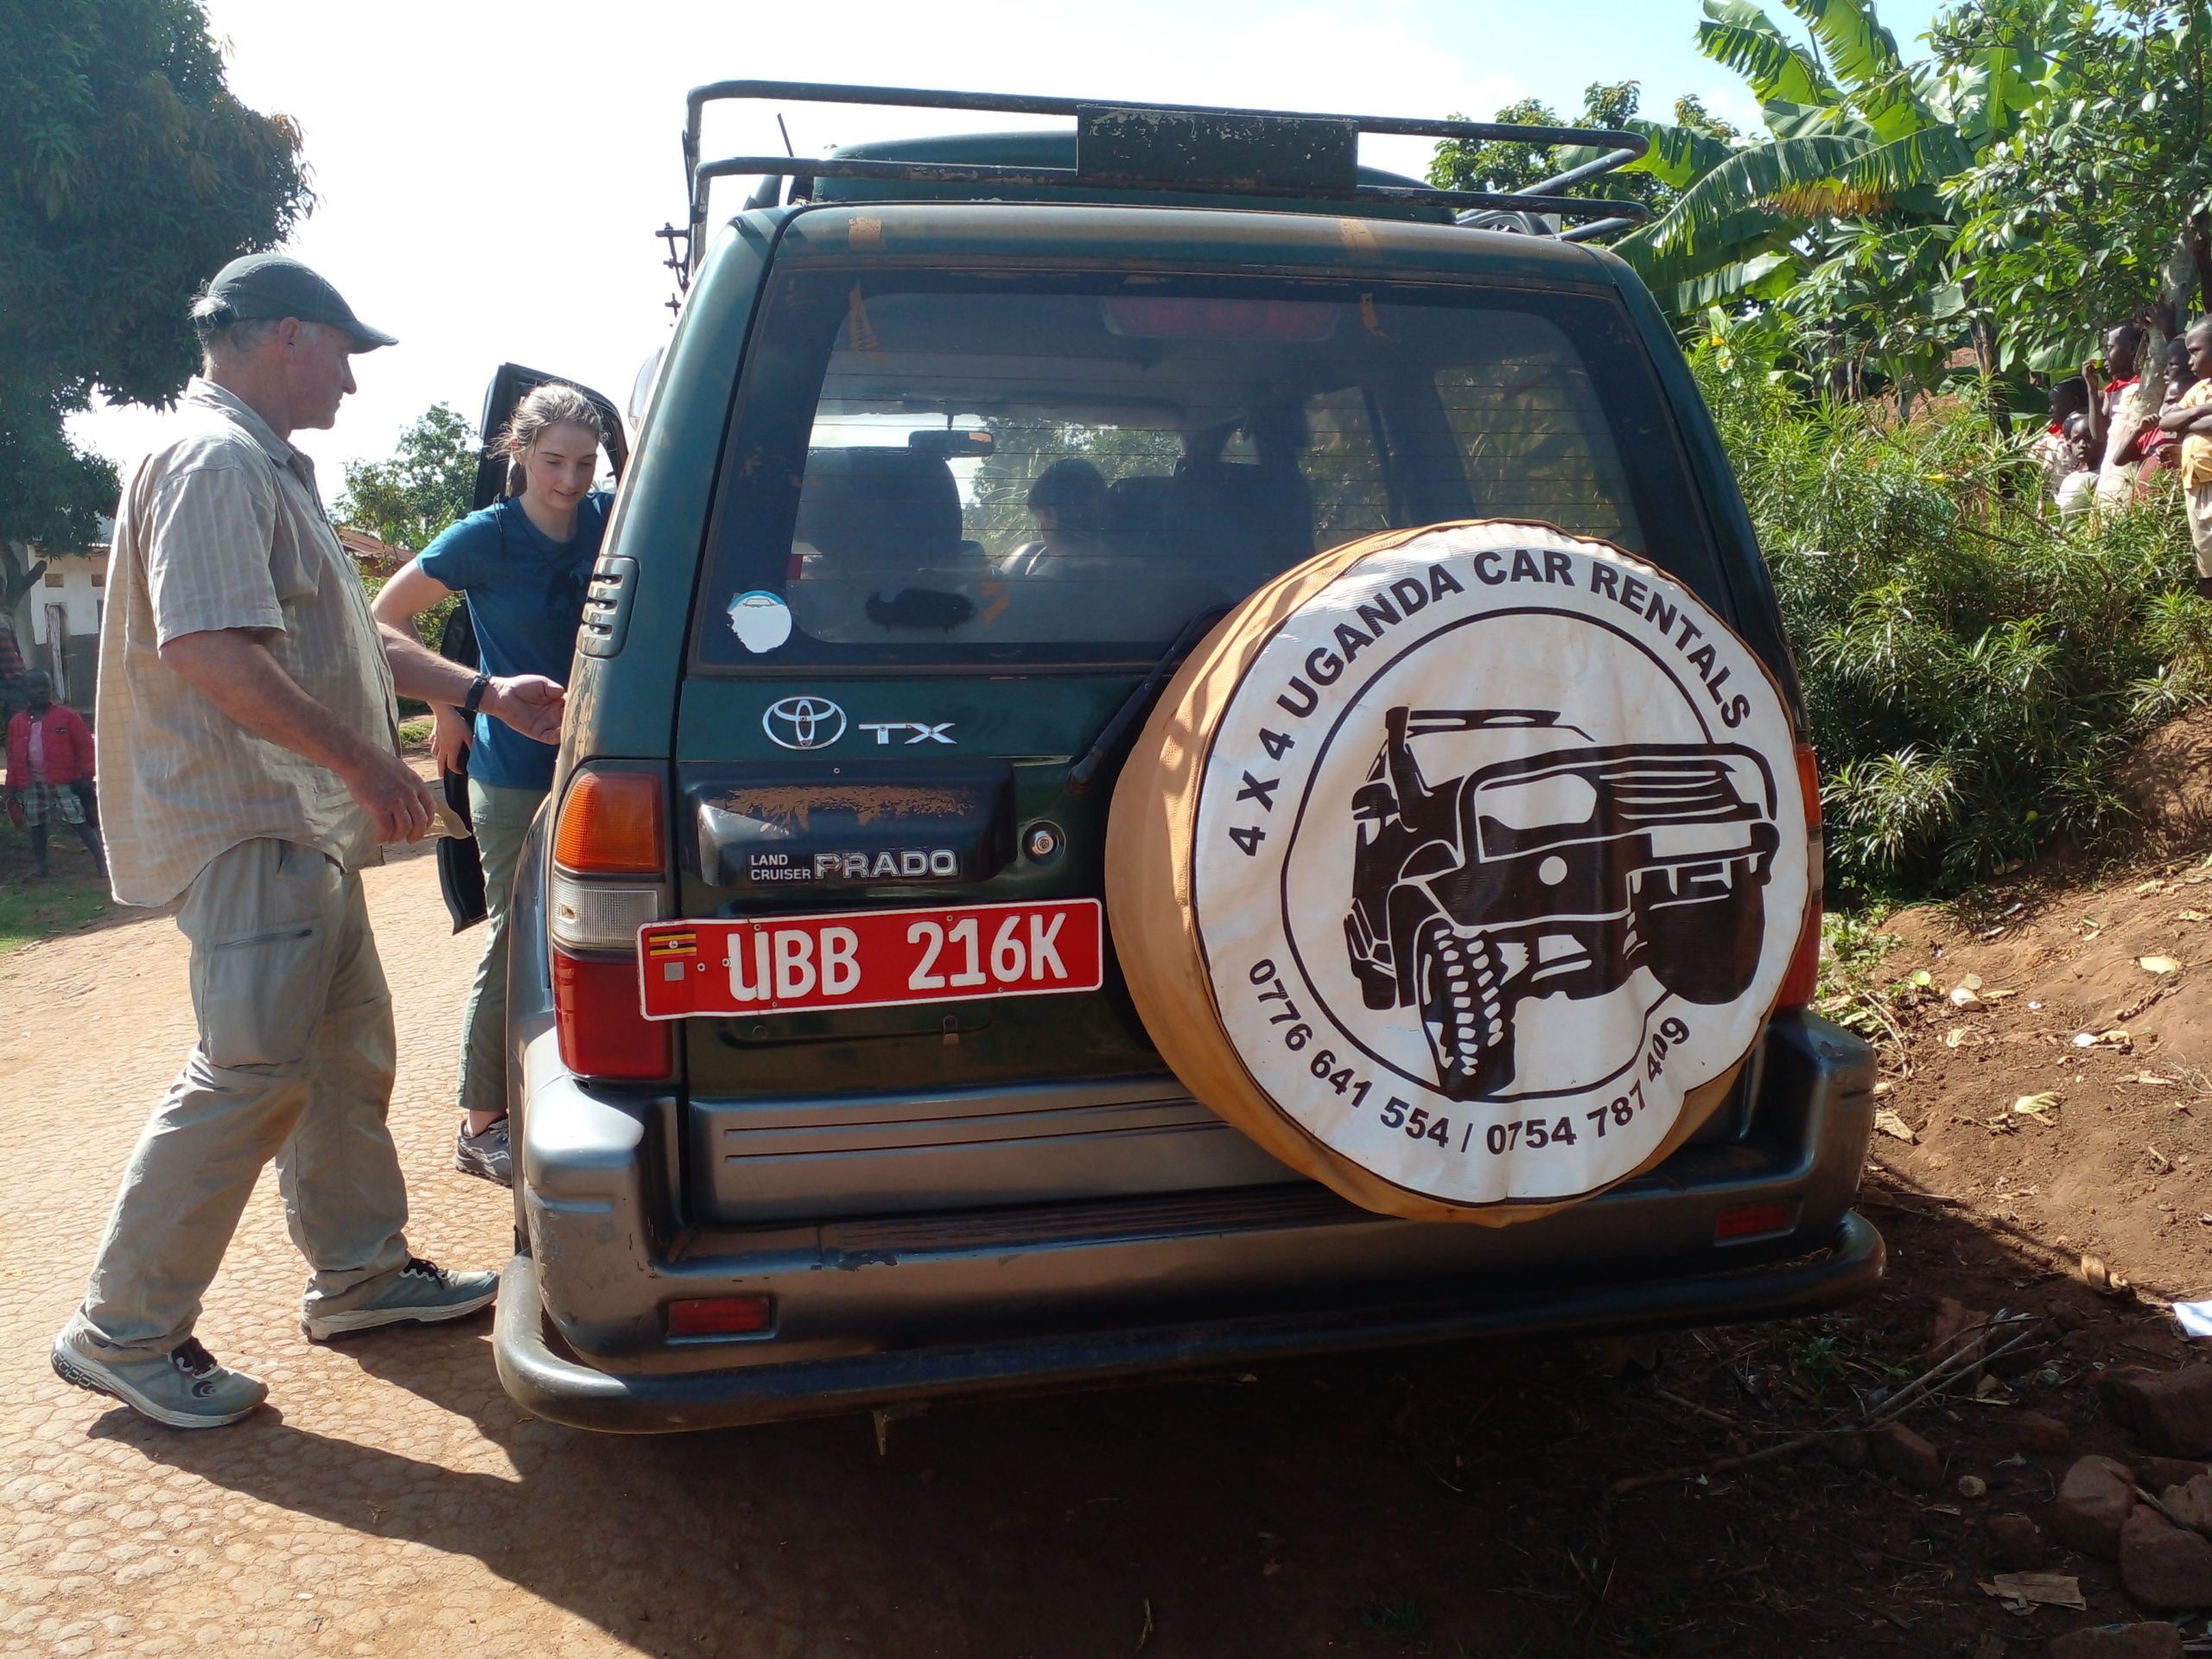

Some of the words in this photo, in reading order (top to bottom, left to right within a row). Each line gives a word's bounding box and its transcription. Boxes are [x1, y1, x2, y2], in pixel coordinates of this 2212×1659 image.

[1473, 550, 1575, 587] CAR
[1275, 563, 1465, 718] UGANDA
[1590, 561, 1751, 728] RENTALS
[858, 722, 957, 745] TX
[1258, 728, 1295, 761] 4
[1229, 826, 1266, 857] 4
[750, 854, 789, 866] LAND
[750, 868, 811, 880] CRUISER
[814, 849, 957, 879] PRADO
[727, 926, 861, 1001] UBB
[906, 912, 1068, 990] 216K
[1249, 958, 1313, 1052] 0776
[1310, 1049, 1373, 1109] 641
[1380, 1096, 1449, 1148] 554
[1460, 1122, 1474, 1154] /
[1486, 1116, 1578, 1155] 0754
[1586, 1077, 1646, 1138] 787
[1647, 1016, 1690, 1083] 409
